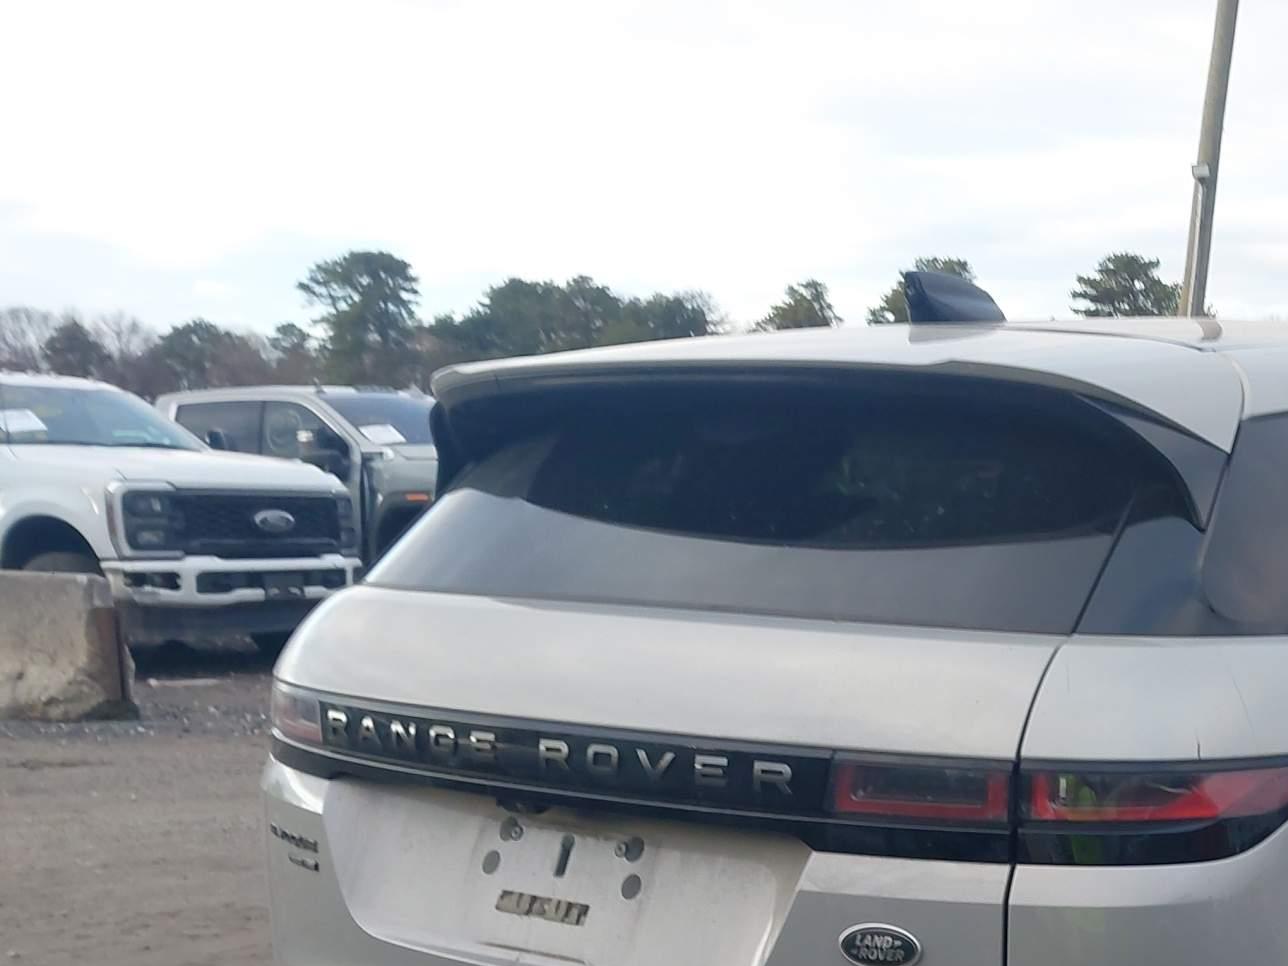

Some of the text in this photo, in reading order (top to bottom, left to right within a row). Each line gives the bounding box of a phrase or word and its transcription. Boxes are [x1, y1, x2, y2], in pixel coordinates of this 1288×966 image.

[326, 708, 793, 794] RANGE ROVER
[855, 933, 894, 950] LAND
[859, 946, 905, 962] ROVER
